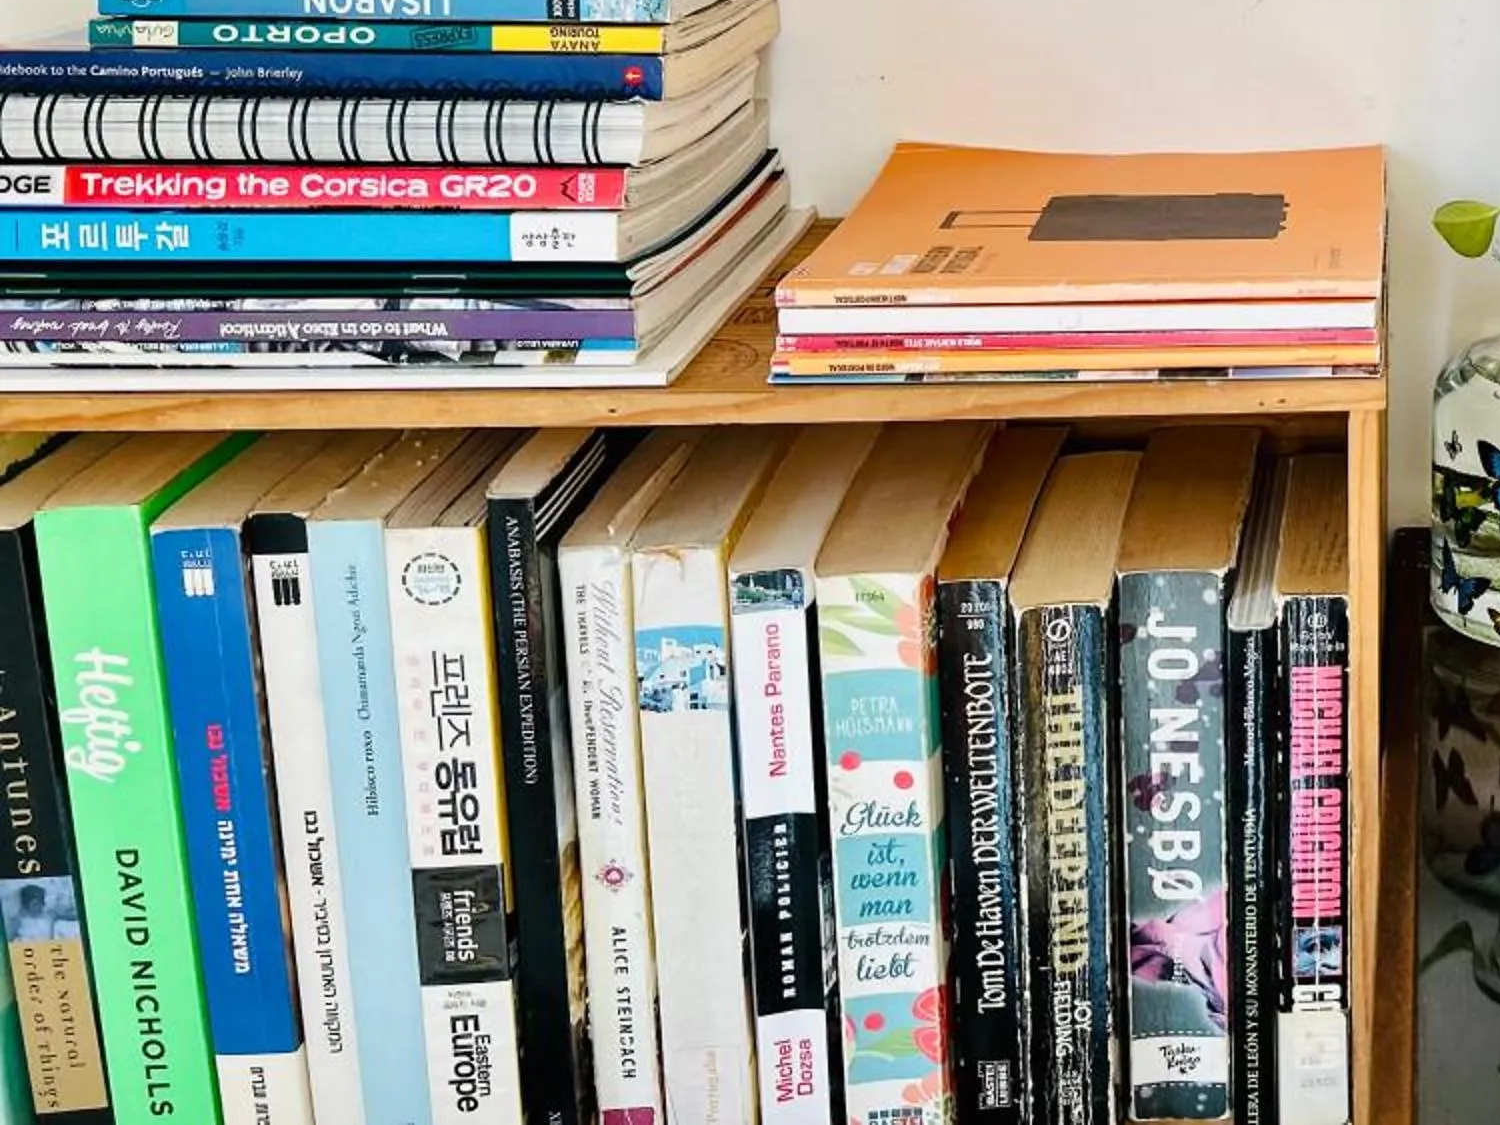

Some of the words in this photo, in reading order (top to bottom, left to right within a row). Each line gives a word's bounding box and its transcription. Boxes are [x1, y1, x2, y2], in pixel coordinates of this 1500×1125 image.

[211, 25, 376, 43] OPORTO
[549, 27, 600, 39] TOURING
[550, 41, 600, 52] ANAYA
[521, 226, 577, 251] 상상출판
[504, 516, 523, 591] ANABASIS
[510, 592, 527, 627] (THE
[512, 629, 531, 690] PERSIAN
[764, 622, 782, 696] Parano
[1146, 610, 1198, 681] JO
[59, 646, 144, 786] Heftig
[430, 650, 473, 752] 프렌즈
[849, 697, 897, 717] PETRA
[518, 694, 540, 785] EXPEDITION)
[767, 701, 789, 779] Nantes
[962, 651, 1000, 817] WELTENBOTE
[435, 758, 483, 857] 동유럽
[840, 800, 923, 836] Glück
[1147, 708, 1203, 901] NESBØ
[773, 822, 793, 920] POLICIER
[970, 818, 1001, 864] DER
[1241, 808, 1257, 881] TENTUDÍA
[115, 848, 151, 948] DAVID
[222, 869, 244, 909] אחת
[850, 870, 919, 890] wenn
[858, 899, 913, 918] man
[975, 868, 1005, 936] Haven
[1244, 883, 1257, 903] DE
[454, 889, 480, 963] friends
[610, 925, 630, 977] ALICE
[845, 924, 931, 949] trotzdem
[976, 940, 1006, 967] De
[1244, 905, 1259, 997] MONASTERIO
[780, 933, 797, 999] ROMAN
[856, 952, 917, 983] liebt
[976, 969, 1007, 1014] Tom
[131, 959, 174, 1118] NICHOLLS
[615, 983, 638, 1080] STEINBACH
[1054, 978, 1073, 1059] FIELDING
[1073, 997, 1093, 1032] JOY
[1246, 998, 1258, 1018] SU
[1246, 1020, 1258, 1029] Y
[448, 1013, 480, 1114] Europe
[476, 1034, 492, 1099] Eastern
[776, 1037, 794, 1103] Michel
[1244, 1032, 1259, 1068] LEÓN
[1246, 1070, 1259, 1089] DE
